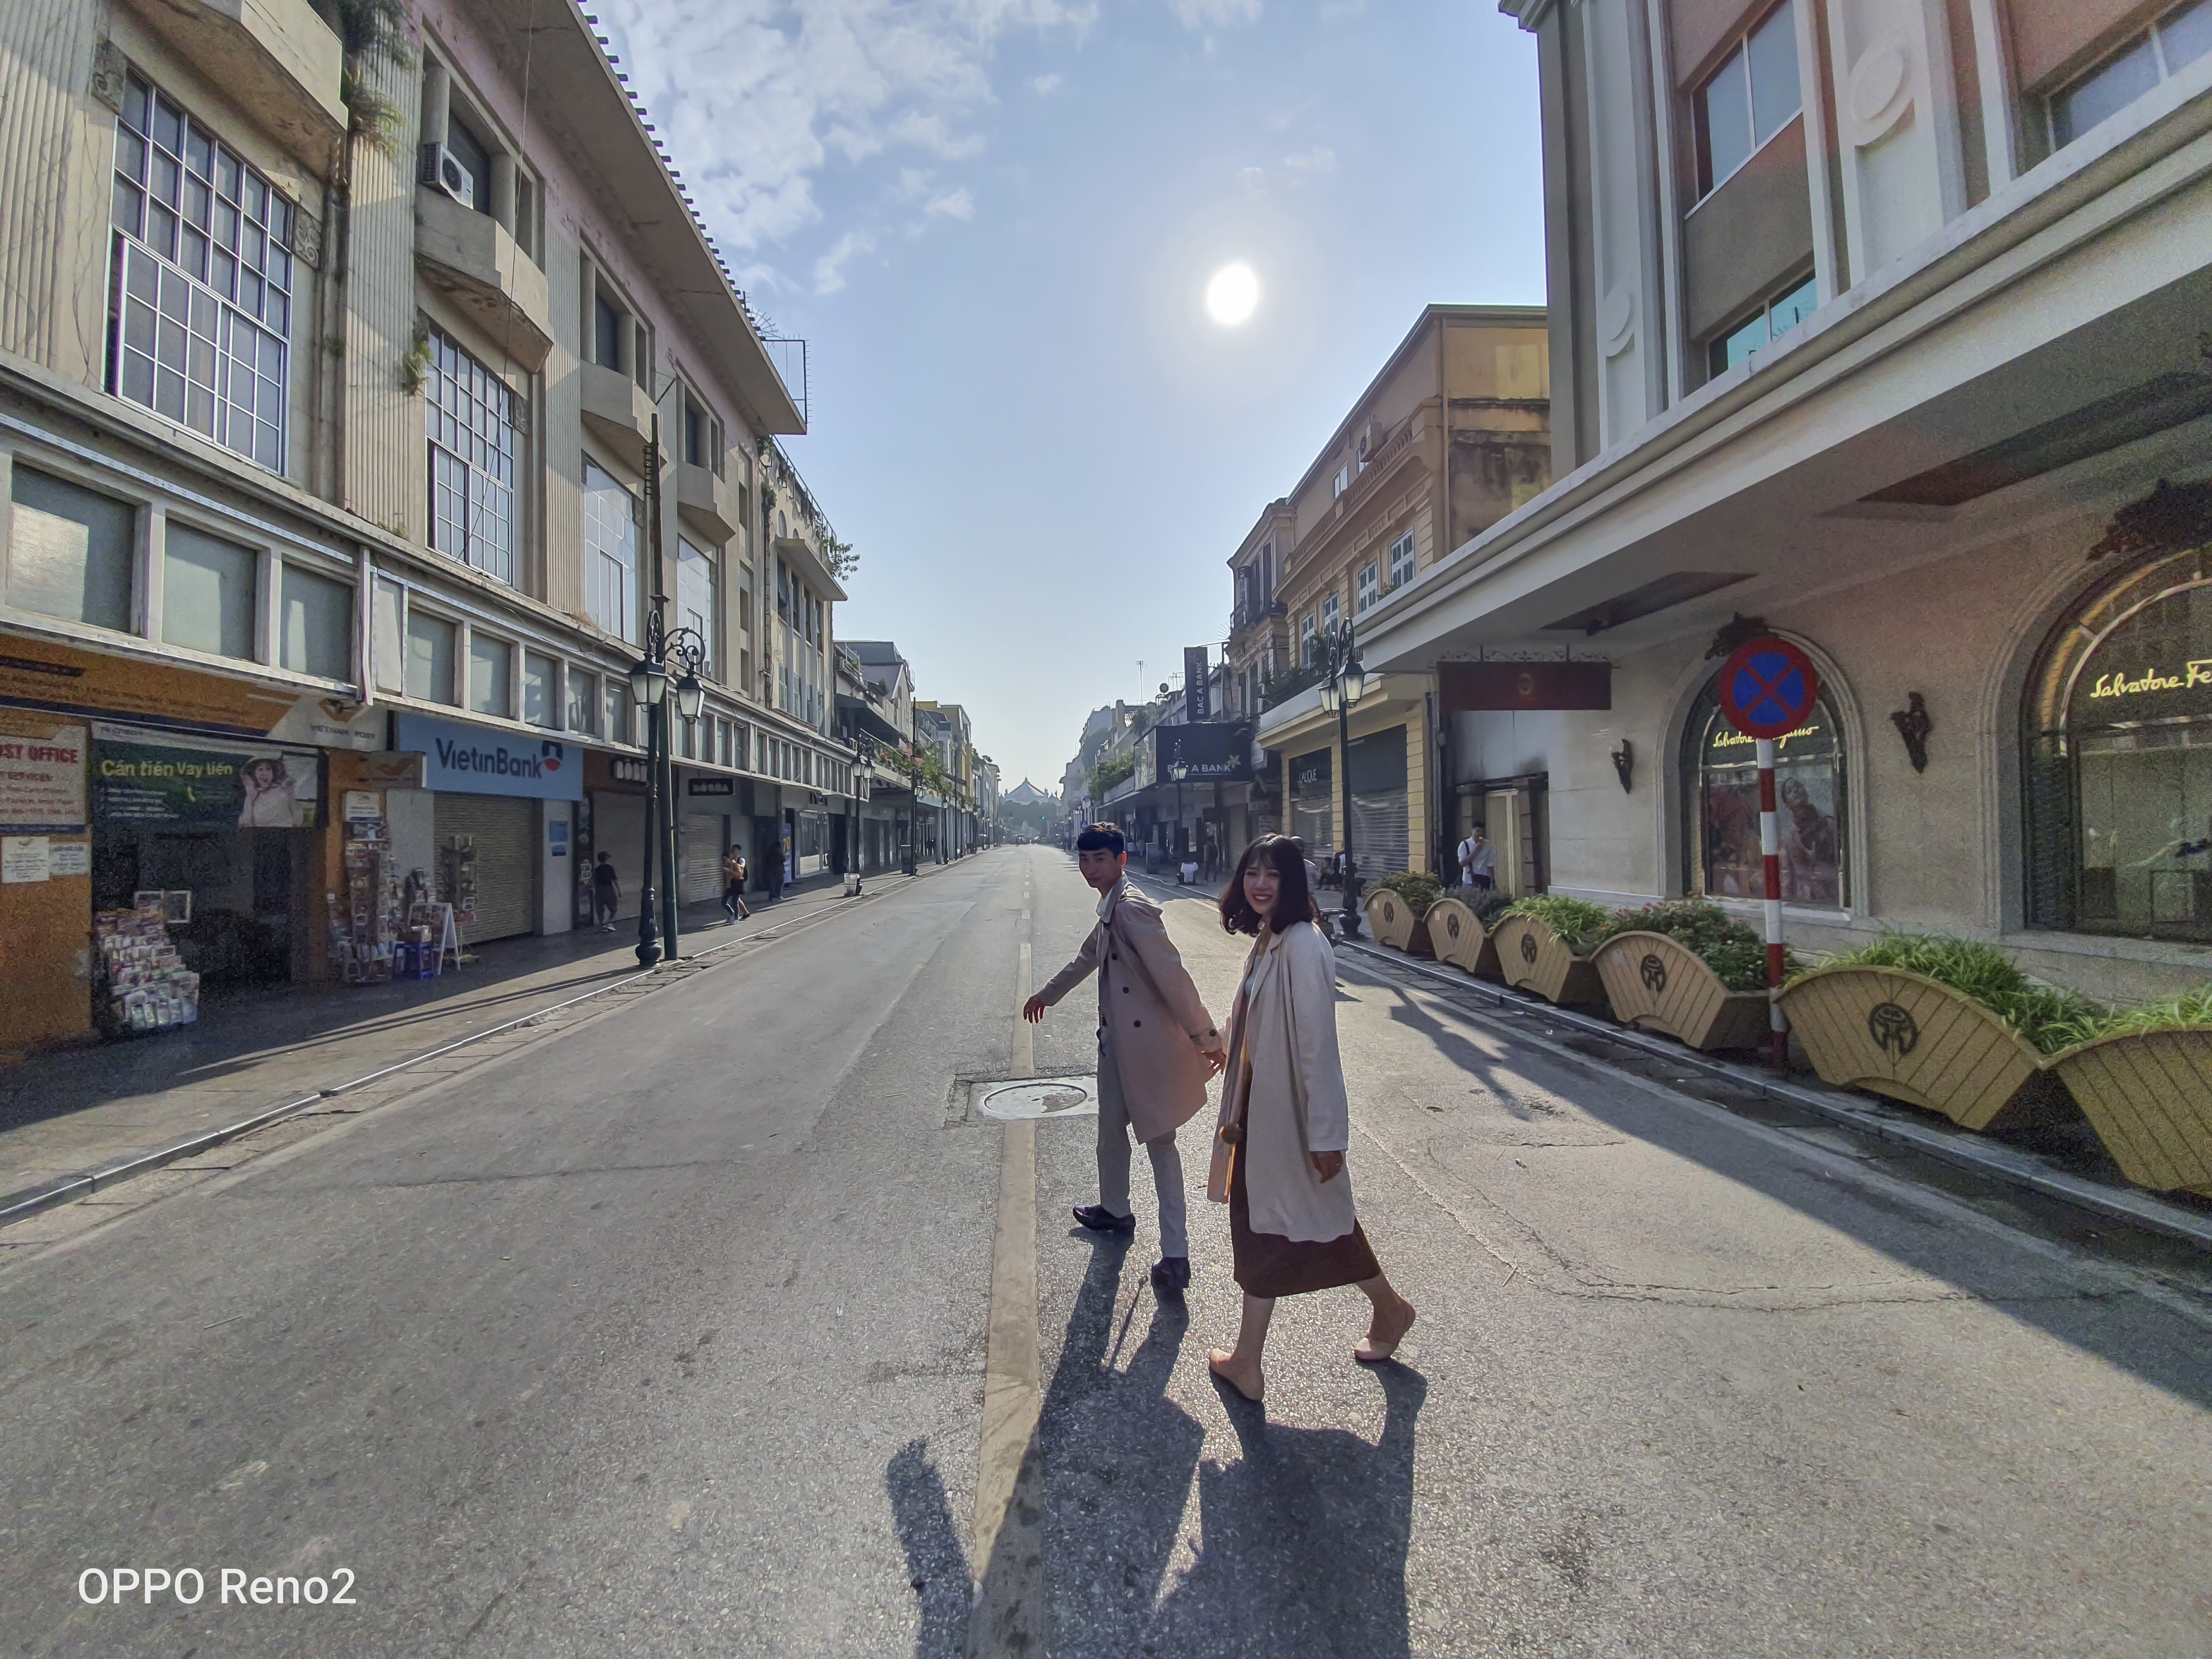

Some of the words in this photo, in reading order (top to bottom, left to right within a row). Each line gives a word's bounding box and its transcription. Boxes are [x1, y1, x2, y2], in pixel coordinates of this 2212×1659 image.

[2090, 668, 2184, 698] Salvatore
[1713, 731, 1755, 747] Salvatore
[28, 745, 79, 764] OFFICE
[436, 737, 542, 779] VietinBank
[1201, 764, 1231, 772] BANK
